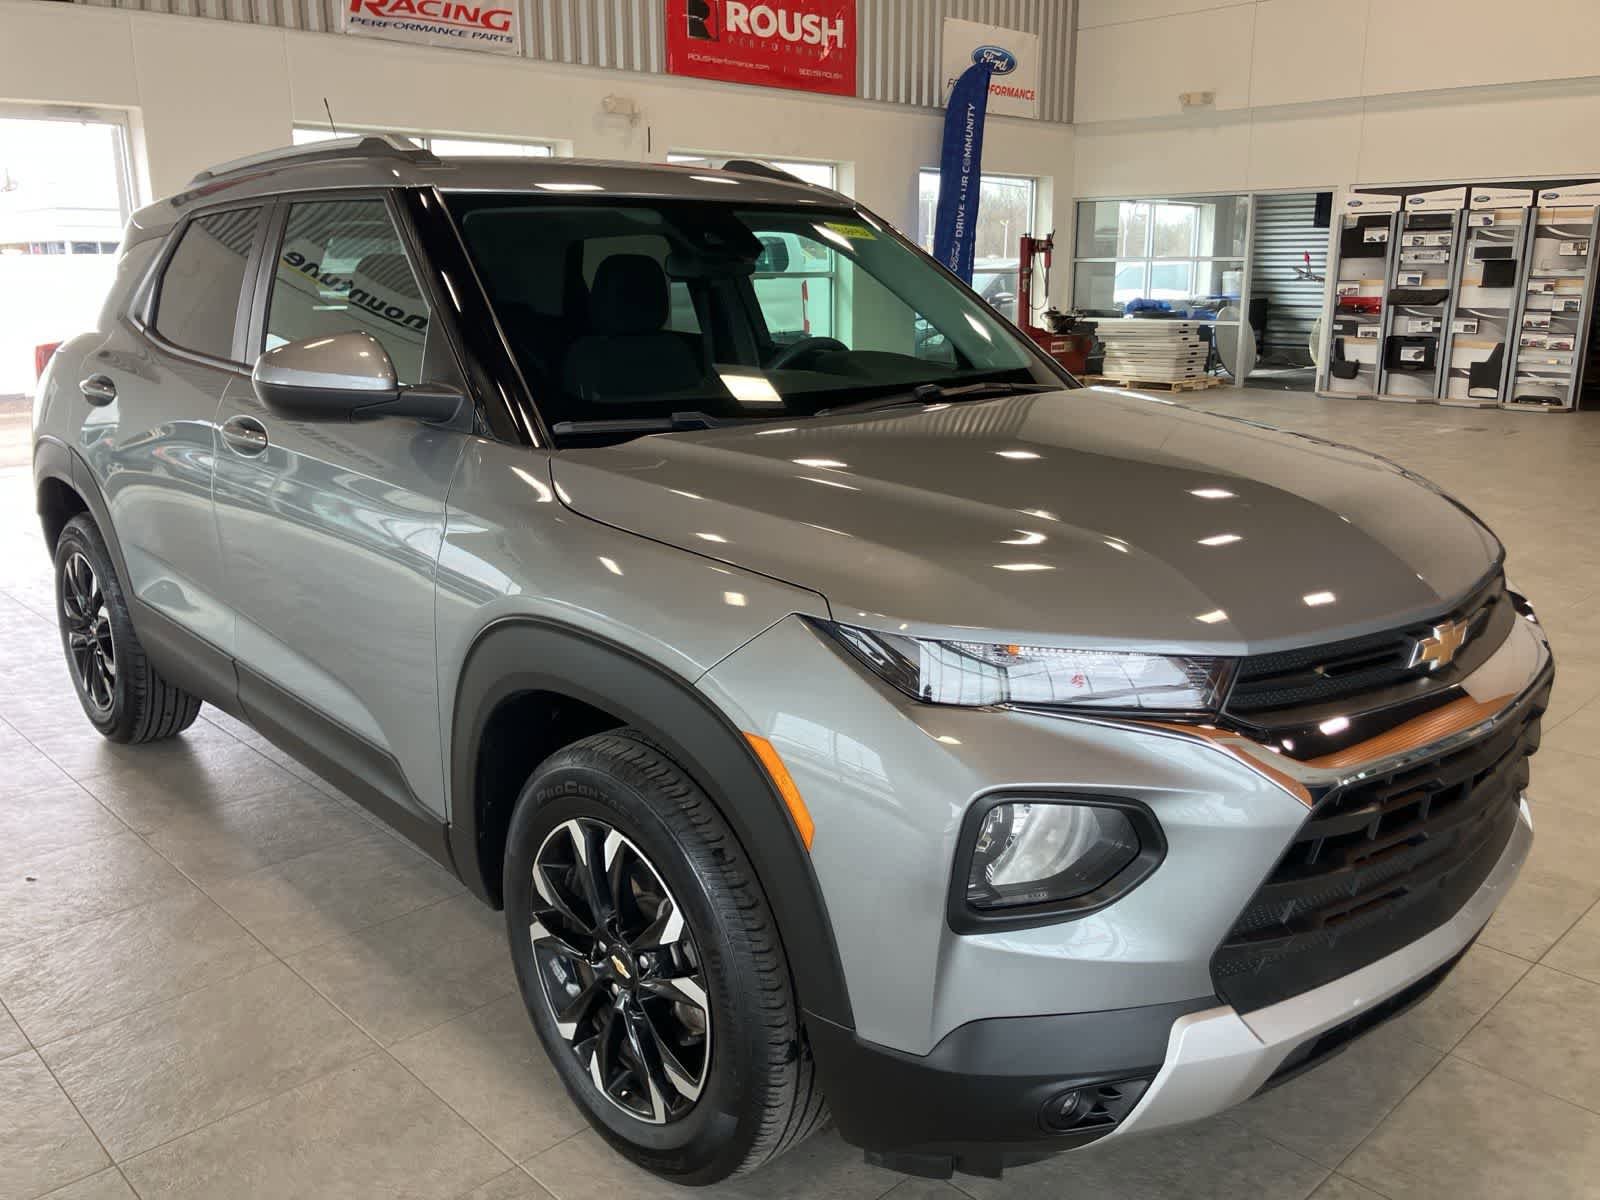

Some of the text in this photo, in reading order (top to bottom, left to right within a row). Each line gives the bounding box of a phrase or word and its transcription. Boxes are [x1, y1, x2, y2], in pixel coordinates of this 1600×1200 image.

[350, 0, 513, 32] RACING
[350, 16, 513, 43] PERFORMANCE PARTS
[726, 0, 844, 49] ROUSH
[955, 203, 965, 238] DRIVE
[962, 103, 976, 173] COMMUNITY
